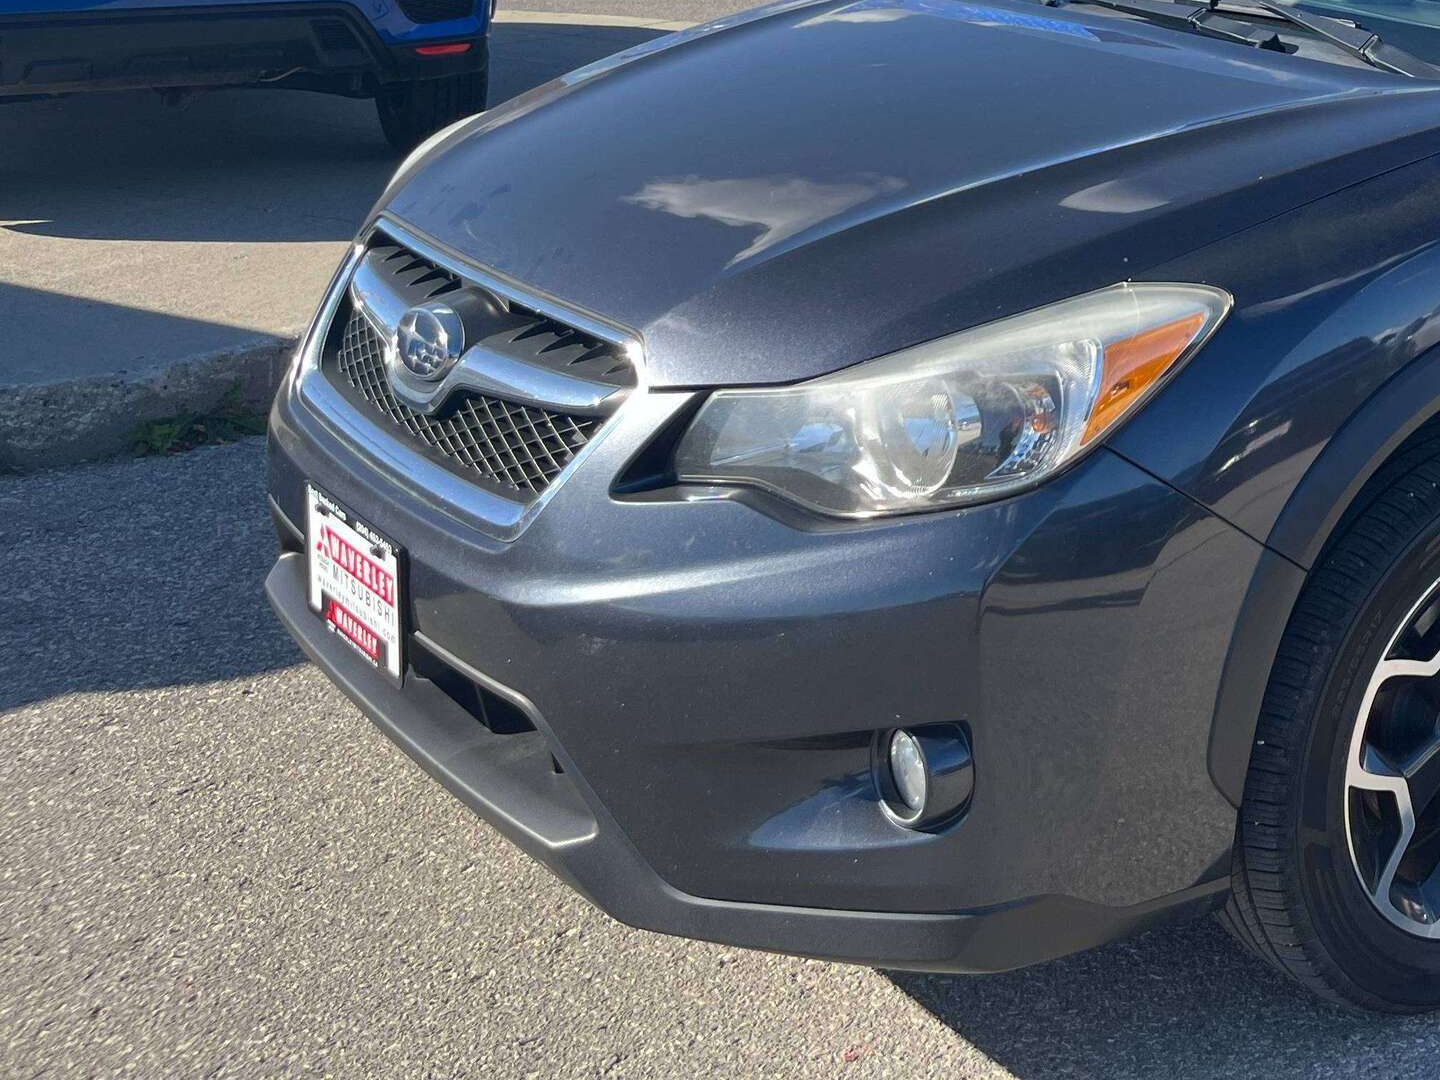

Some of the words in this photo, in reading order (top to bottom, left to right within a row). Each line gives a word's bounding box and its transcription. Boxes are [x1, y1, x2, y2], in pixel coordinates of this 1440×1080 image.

[329, 529, 394, 605] WAVERLEY
[332, 563, 395, 628] MITSUBISHI
[335, 605, 378, 656] WAVERLEY
